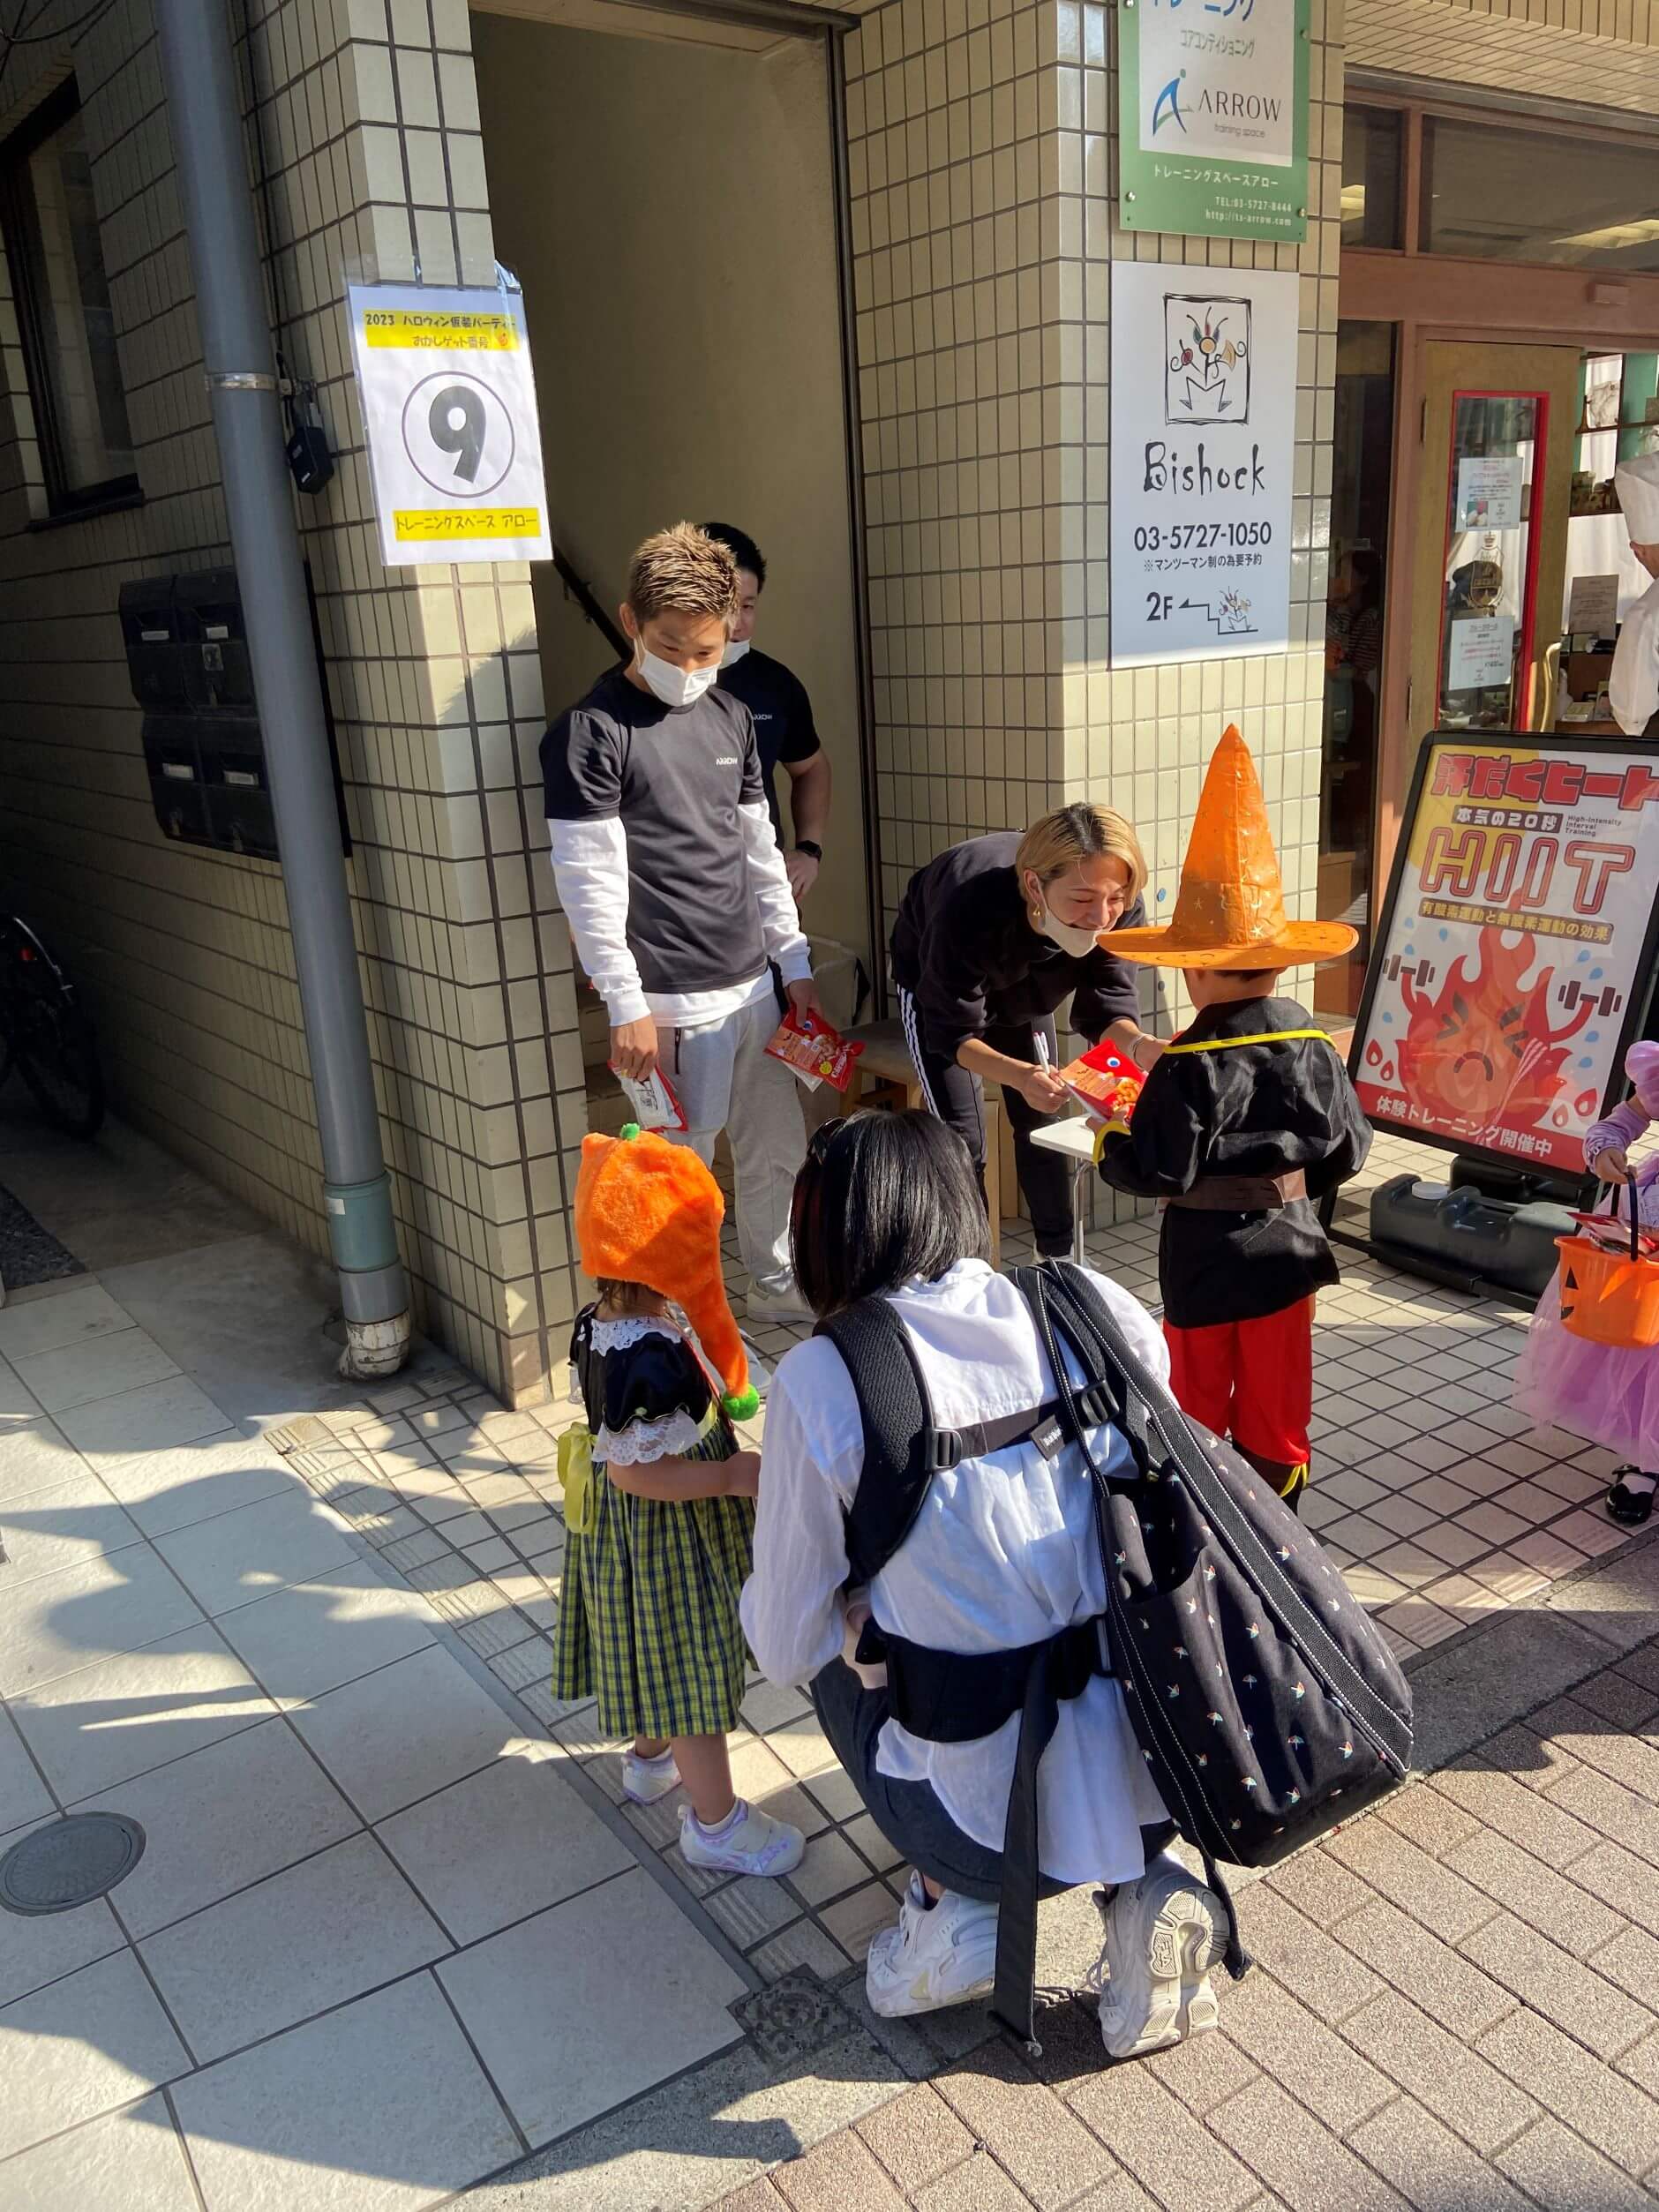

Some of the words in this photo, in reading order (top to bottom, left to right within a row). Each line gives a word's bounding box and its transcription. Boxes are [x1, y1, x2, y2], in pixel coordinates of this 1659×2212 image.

[1198, 88, 1281, 122] ARROW
[1154, 164, 1279, 188] トレーニングスペースアロー
[365, 313, 395, 326] 2023
[412, 335, 489, 349] おかしゲット番号
[429, 385, 486, 484] 9
[1144, 440, 1265, 496] Bishock
[396, 516, 495, 531] トレーニングスペース
[503, 514, 537, 527] アロー
[1134, 521, 1272, 551] 03-5727-1050
[1145, 591, 1174, 622] 2F
[1430, 754, 1659, 812] 汗だくヒート
[1455, 806, 1559, 832] 本気の20秒
[1565, 828, 1596, 837] Training
[1566, 821, 1596, 830] Interval
[1417, 827, 1636, 916] HIIT
[1422, 902, 1610, 941] 有酸素運動と無酸素運動の効果
[1376, 1095, 1553, 1158] 体験トレーニング開催中
